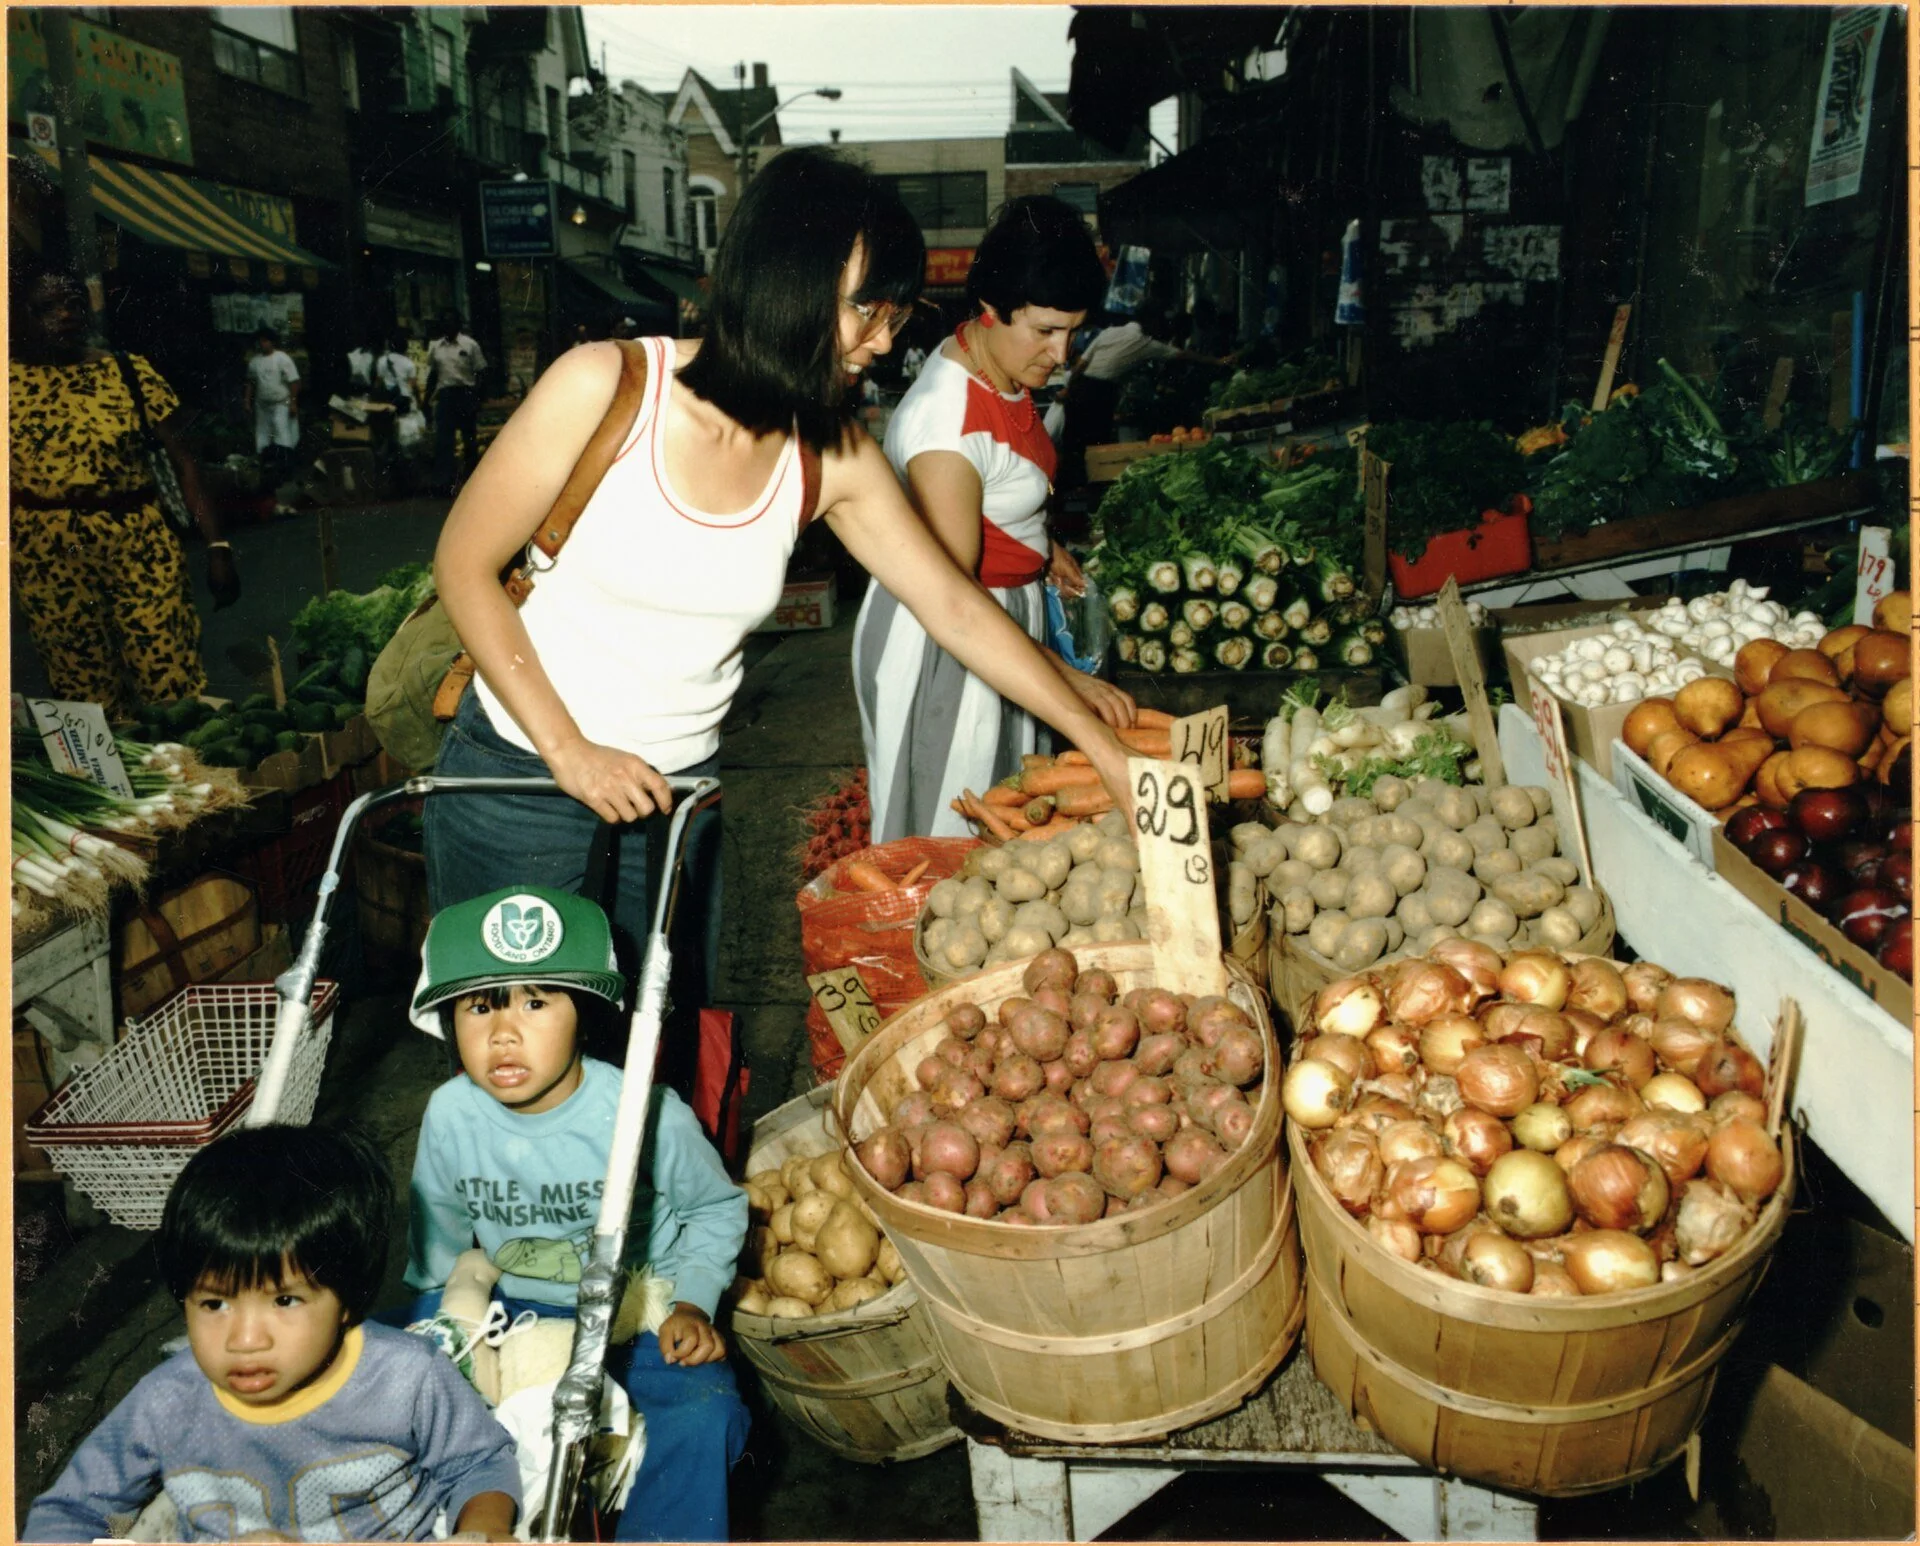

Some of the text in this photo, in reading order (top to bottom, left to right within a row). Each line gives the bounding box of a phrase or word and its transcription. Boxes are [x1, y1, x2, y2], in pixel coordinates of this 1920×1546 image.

[1858, 547, 1886, 582] 179
[776, 601, 822, 628] Dole
[1180, 715, 1225, 790] 49
[1136, 771, 1199, 846] 29
[491, 920, 556, 960] FOODLAND ONTARIO
[814, 976, 874, 1012] 39
[540, 1179, 605, 1205] MISS
[467, 1200, 592, 1227] SUNSHINE
